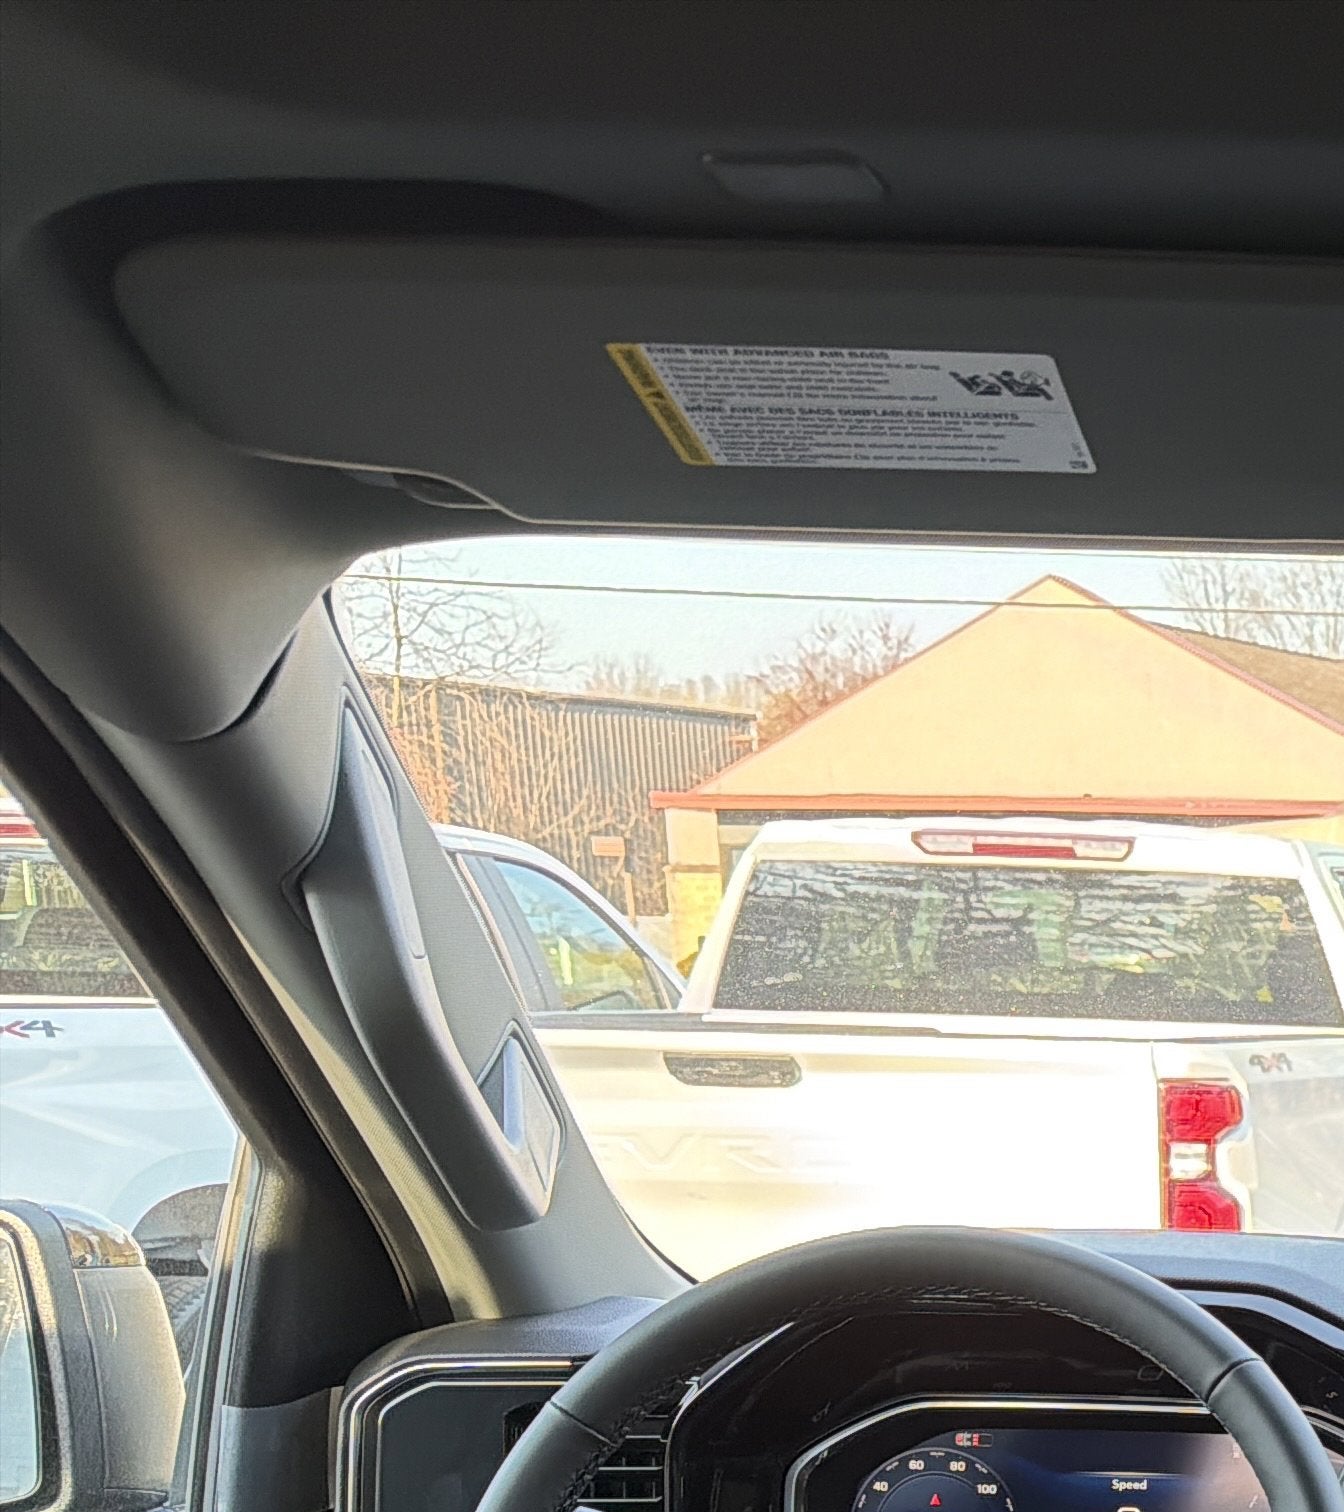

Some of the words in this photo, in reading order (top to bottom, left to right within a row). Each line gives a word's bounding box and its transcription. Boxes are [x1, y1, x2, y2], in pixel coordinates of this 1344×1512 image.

[908, 1460, 924, 1470] 60
[950, 1461, 966, 1471] 80
[873, 1482, 888, 1492] 40
[977, 1484, 997, 1494] 100
[1112, 1479, 1147, 1491] Speed
